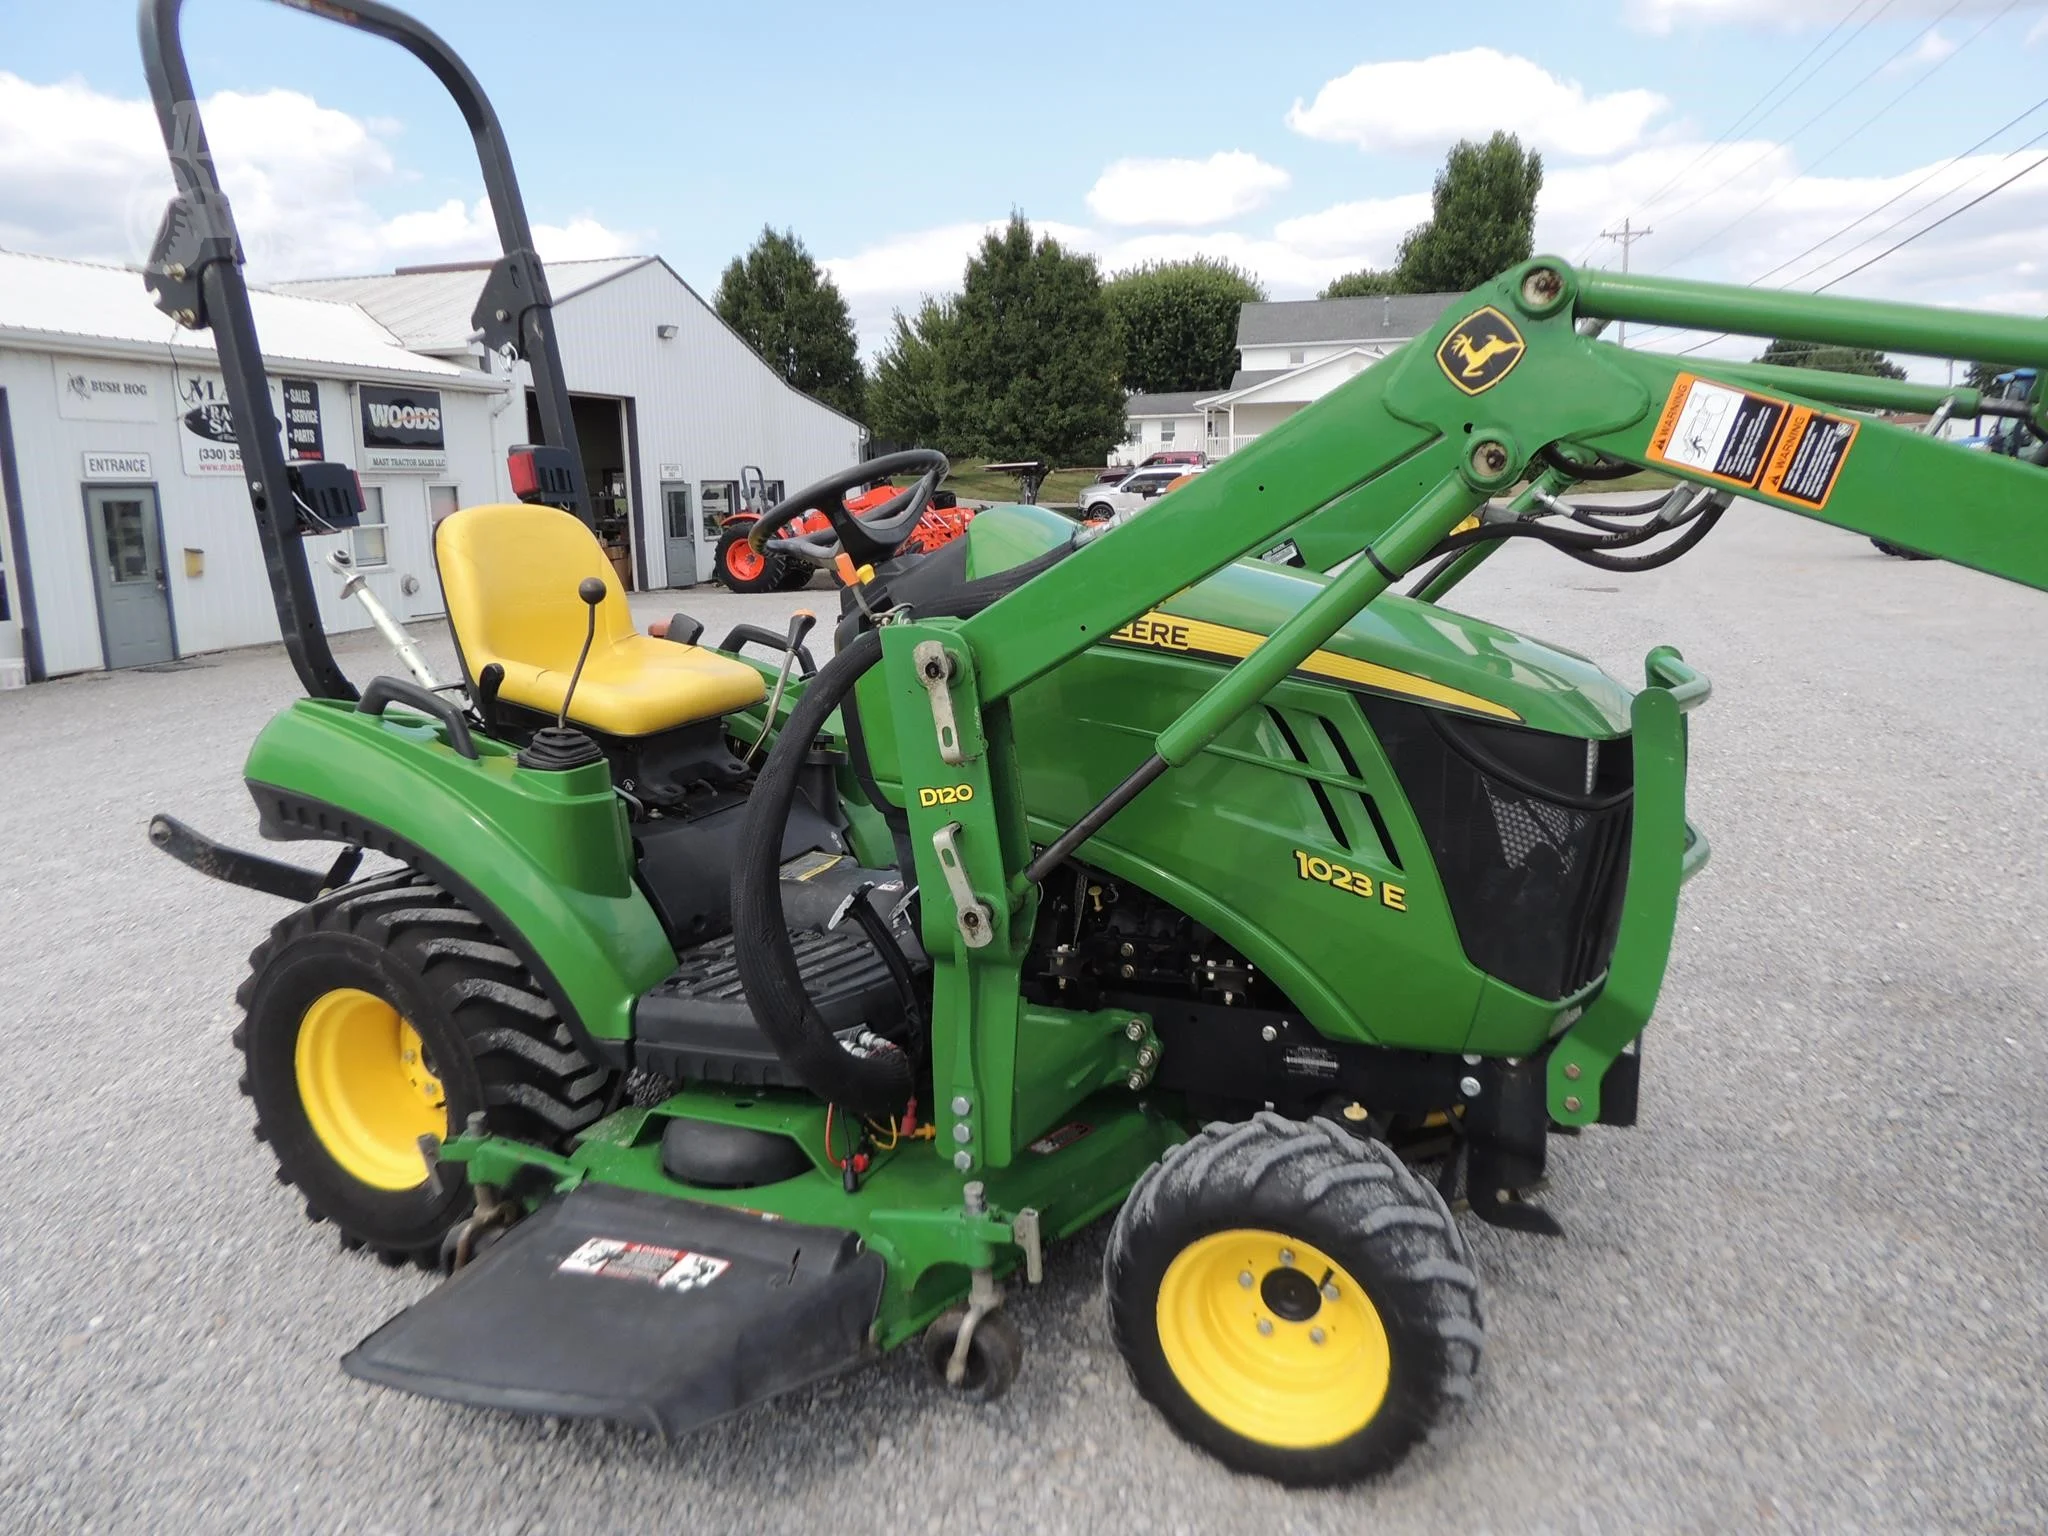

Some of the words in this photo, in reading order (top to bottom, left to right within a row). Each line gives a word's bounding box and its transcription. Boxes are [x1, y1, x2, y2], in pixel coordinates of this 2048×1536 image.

[90, 380, 120, 393] BUSH
[123, 383, 147, 396] HOG
[289, 388, 311, 403] SALES
[291, 408, 319, 424] SERVICE
[368, 403, 441, 430] WOODS
[1661, 383, 1688, 436] WARNING
[293, 428, 316, 443] PARTS
[1777, 416, 1806, 470] WARNING
[88, 458, 147, 473] ENTRANCE
[1293, 849, 1374, 898] 1023
[1380, 881, 1407, 912] E
